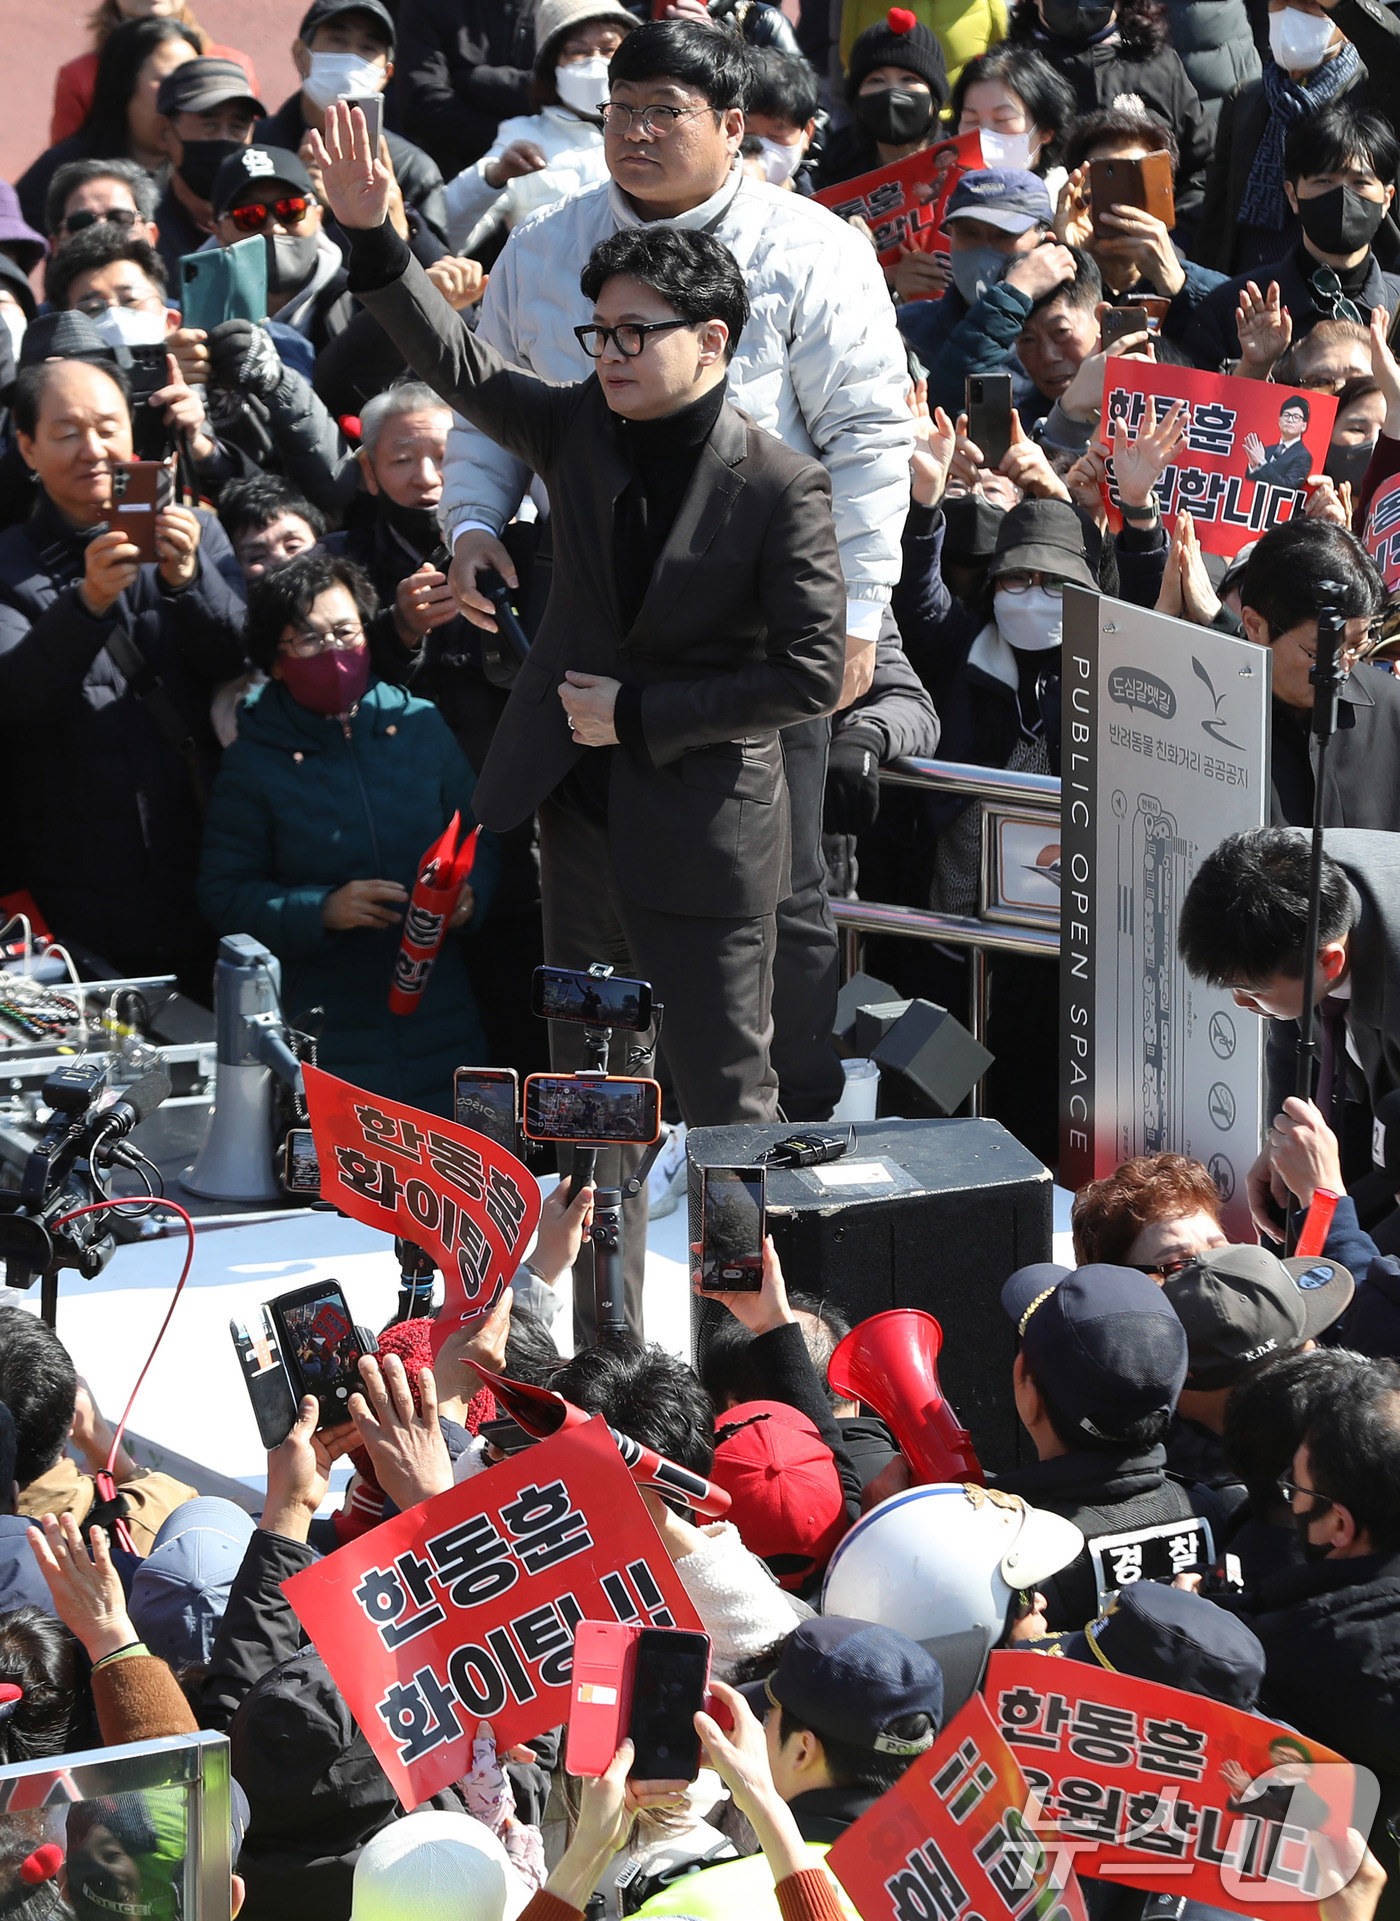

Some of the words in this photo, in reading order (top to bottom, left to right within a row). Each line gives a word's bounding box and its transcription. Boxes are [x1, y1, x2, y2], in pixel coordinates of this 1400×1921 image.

[1072, 655, 1090, 828] PUBLIC
[1109, 722, 1154, 758] 반려동물
[1156, 739, 1201, 773] 친화거리
[1203, 755, 1249, 789] 공공공지
[1112, 676, 1171, 715] 도심갈맷길
[1071, 853, 1089, 980] OPEN
[1069, 1004, 1088, 1152] SPACE
[353, 1104, 528, 1256] 한동훈
[352, 1479, 595, 1652] 한동훈
[1000, 1686, 1208, 1783] 한동훈
